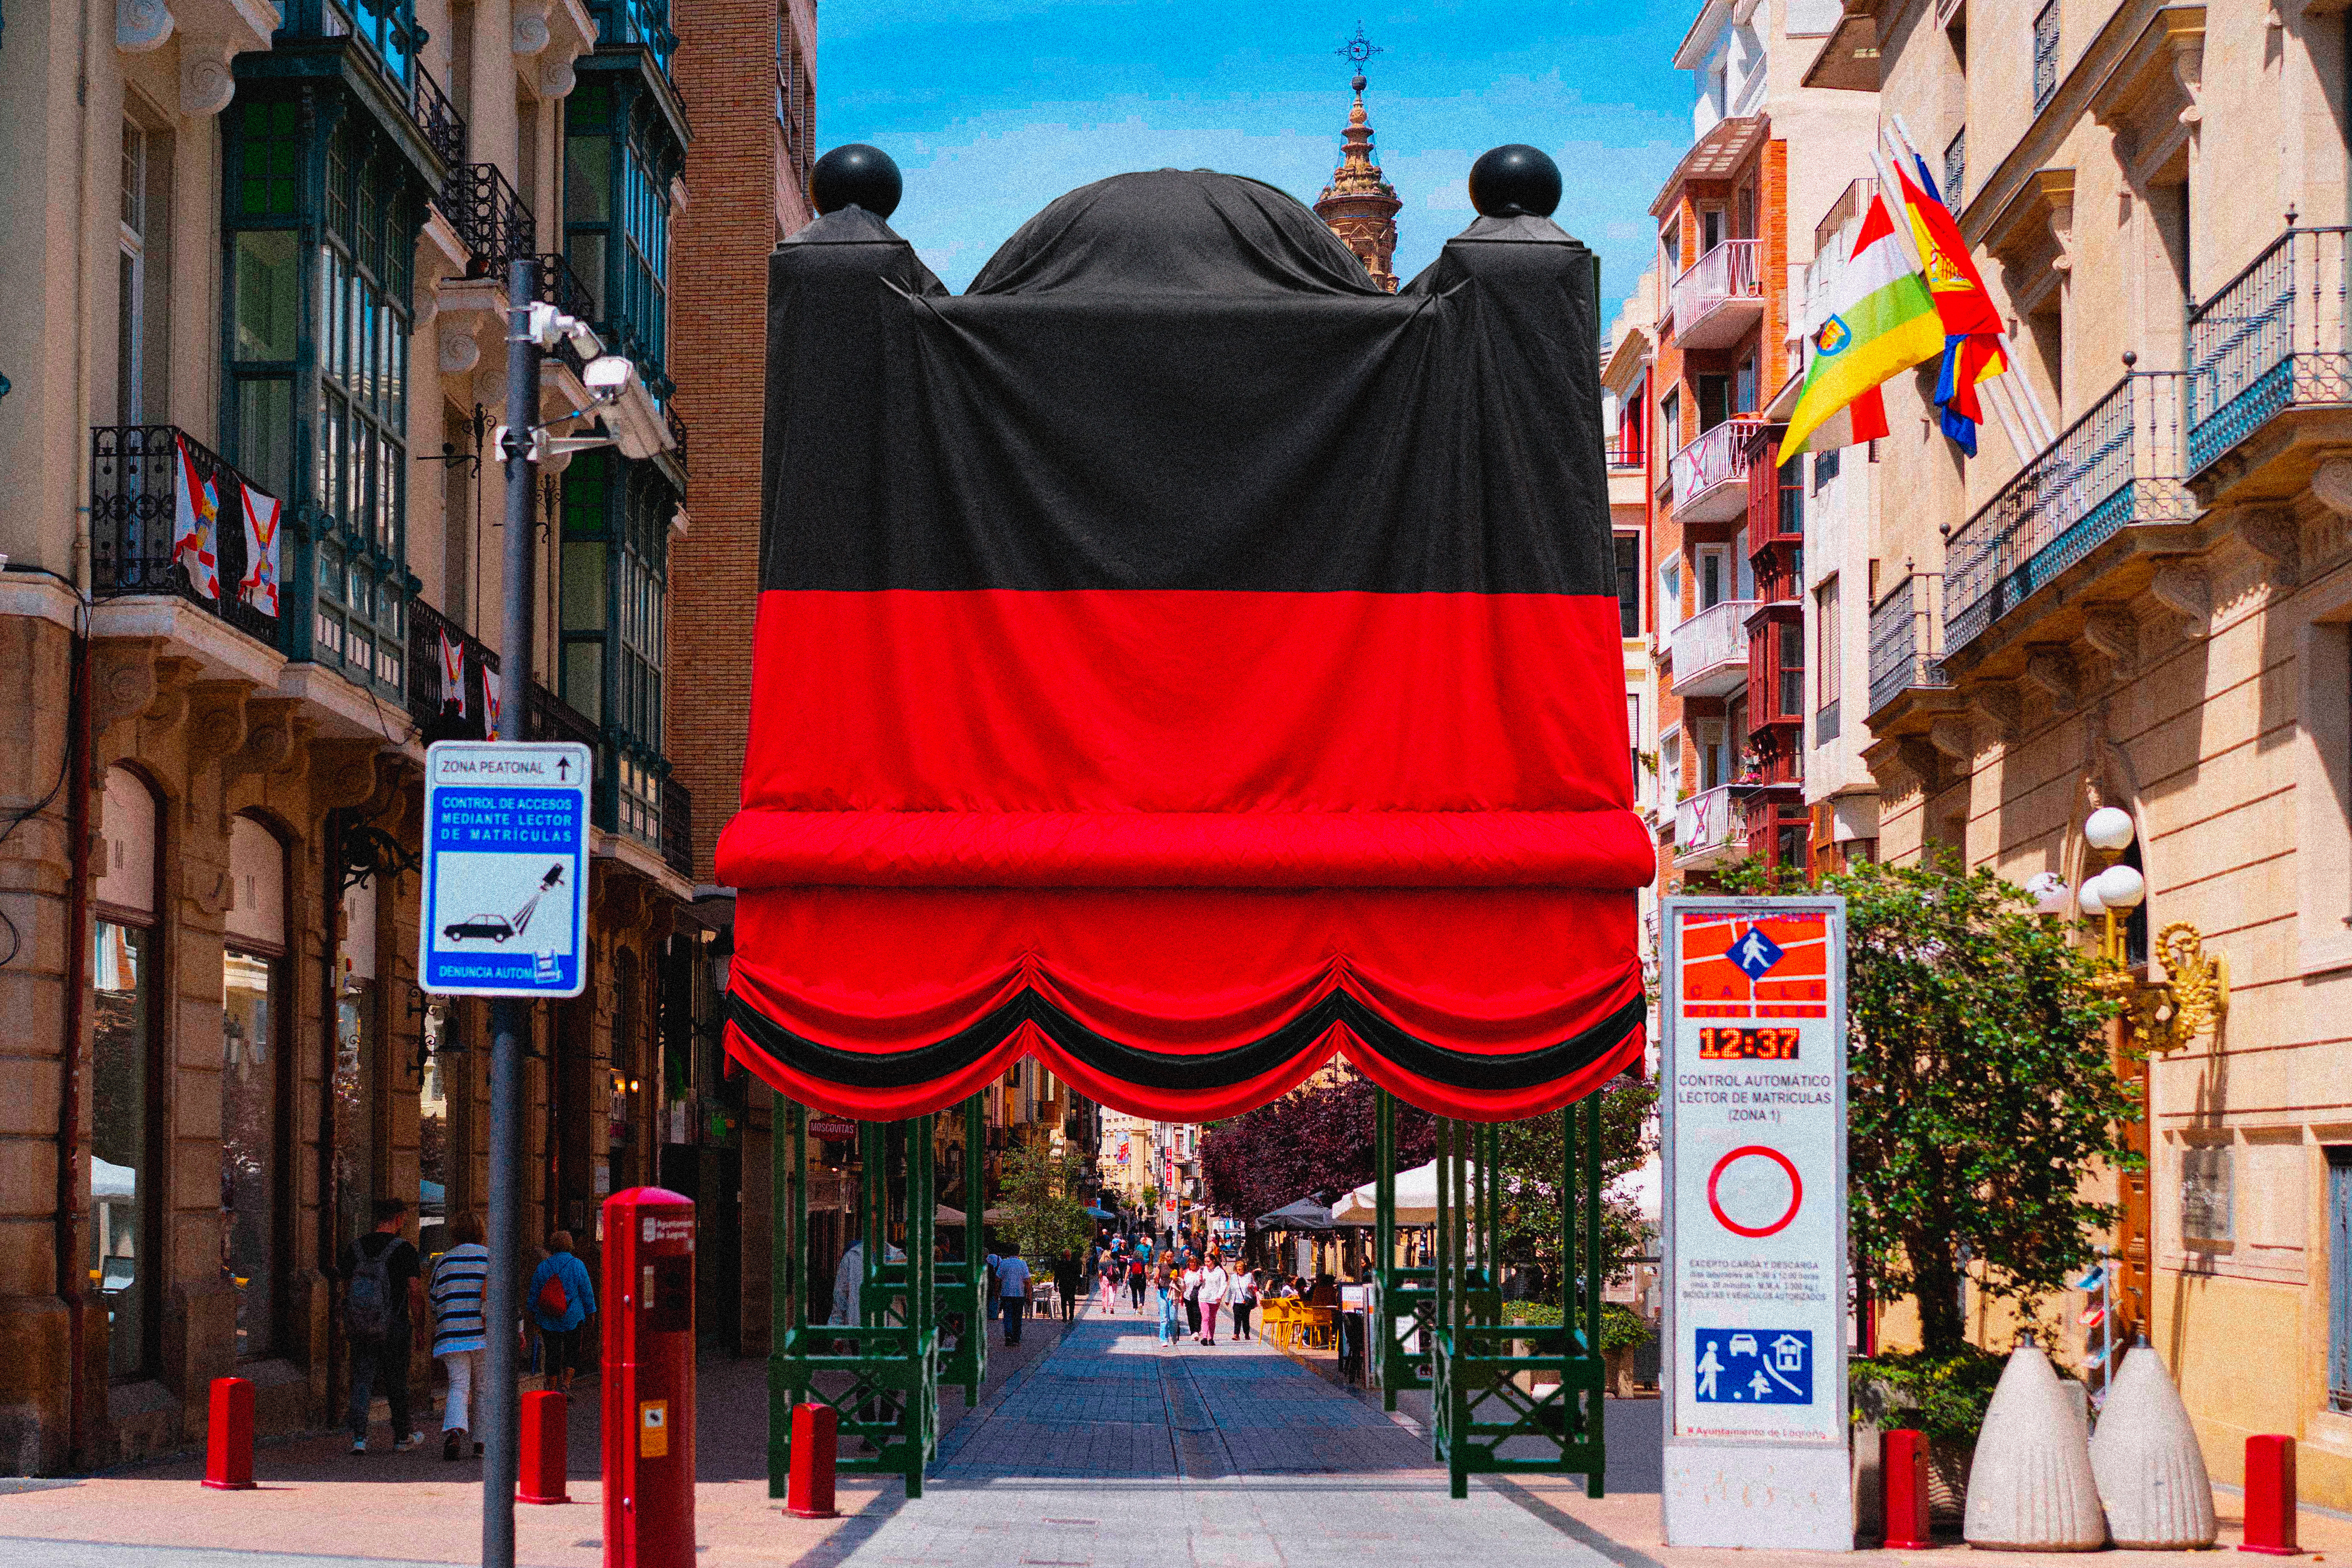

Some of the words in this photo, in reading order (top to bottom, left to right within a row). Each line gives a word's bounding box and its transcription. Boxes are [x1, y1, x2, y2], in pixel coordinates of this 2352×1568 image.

[442, 761, 476, 773] ZONA
[480, 761, 544, 774] PEATONAL
[442, 797, 497, 809] CONTROL
[499, 797, 515, 809] DE
[517, 798, 572, 811] ACCESOS
[442, 813, 510, 825] MEDIANTE
[518, 814, 572, 826] LECTOR
[441, 828, 460, 840] DE
[470, 828, 571, 842] MATRÍCULAS
[439, 965, 492, 978] DENUNCIA
[1691, 985, 1820, 998] CALLE
[1689, 1005, 1824, 1017] PORTALES
[1700, 1028, 1798, 1058] 12:37
[1679, 1075, 1741, 1087] CONTROL
[1744, 1073, 1831, 1087] AUTOMÁTICO
[1679, 1092, 1728, 1103] LECTOR
[1732, 1092, 1748, 1103] DE
[1729, 1109, 1766, 1122] (ZONA
[1771, 1109, 1781, 1123] 1)
[811, 1122, 855, 1134] MOSCOVITAS
[1689, 1259, 1729, 1268] EXCEPTO
[1731, 1260, 1761, 1268] CARGA
[1771, 1260, 1818, 1269] DESCARGA
[1682, 1290, 1724, 1299] BICICLETAS
[1775, 1292, 1826, 1301] AUTORIZADOS
[1697, 1427, 1764, 1437] Ayuntamiento
